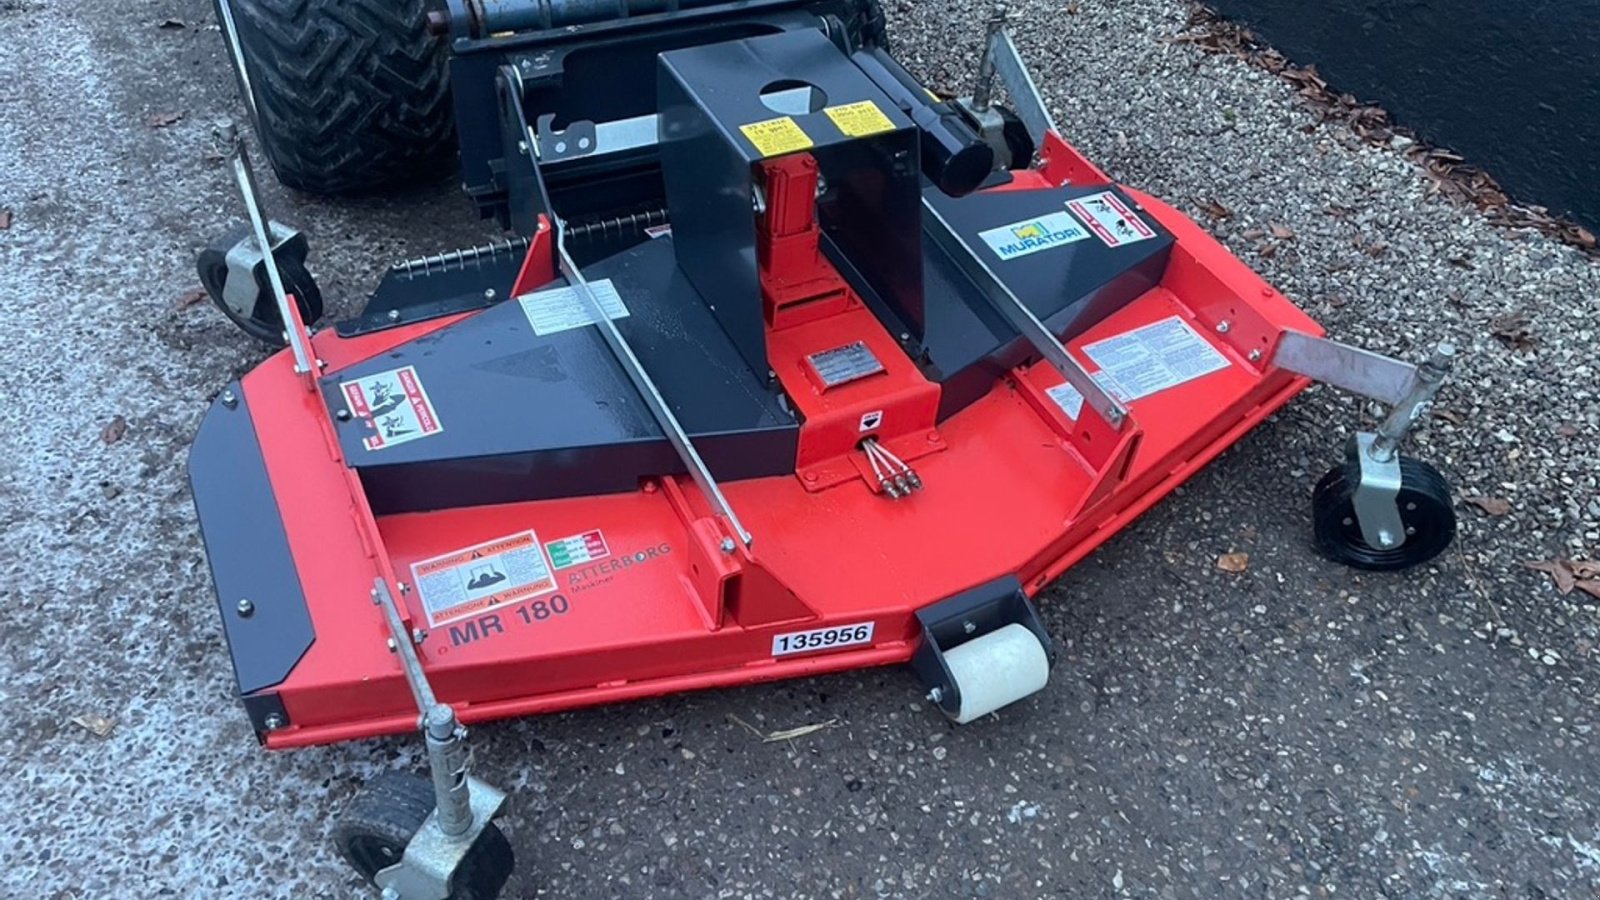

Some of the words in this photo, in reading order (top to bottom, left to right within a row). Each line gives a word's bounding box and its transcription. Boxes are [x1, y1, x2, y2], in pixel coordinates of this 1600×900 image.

[998, 228, 1082, 255] MURATORI
[422, 556, 465, 571] WARNING
[487, 537, 531, 552] ATTENTION
[569, 543, 671, 585] ATTERBORG
[449, 614, 504, 646] MR
[516, 594, 568, 624] 180
[779, 626, 868, 651] 135956
